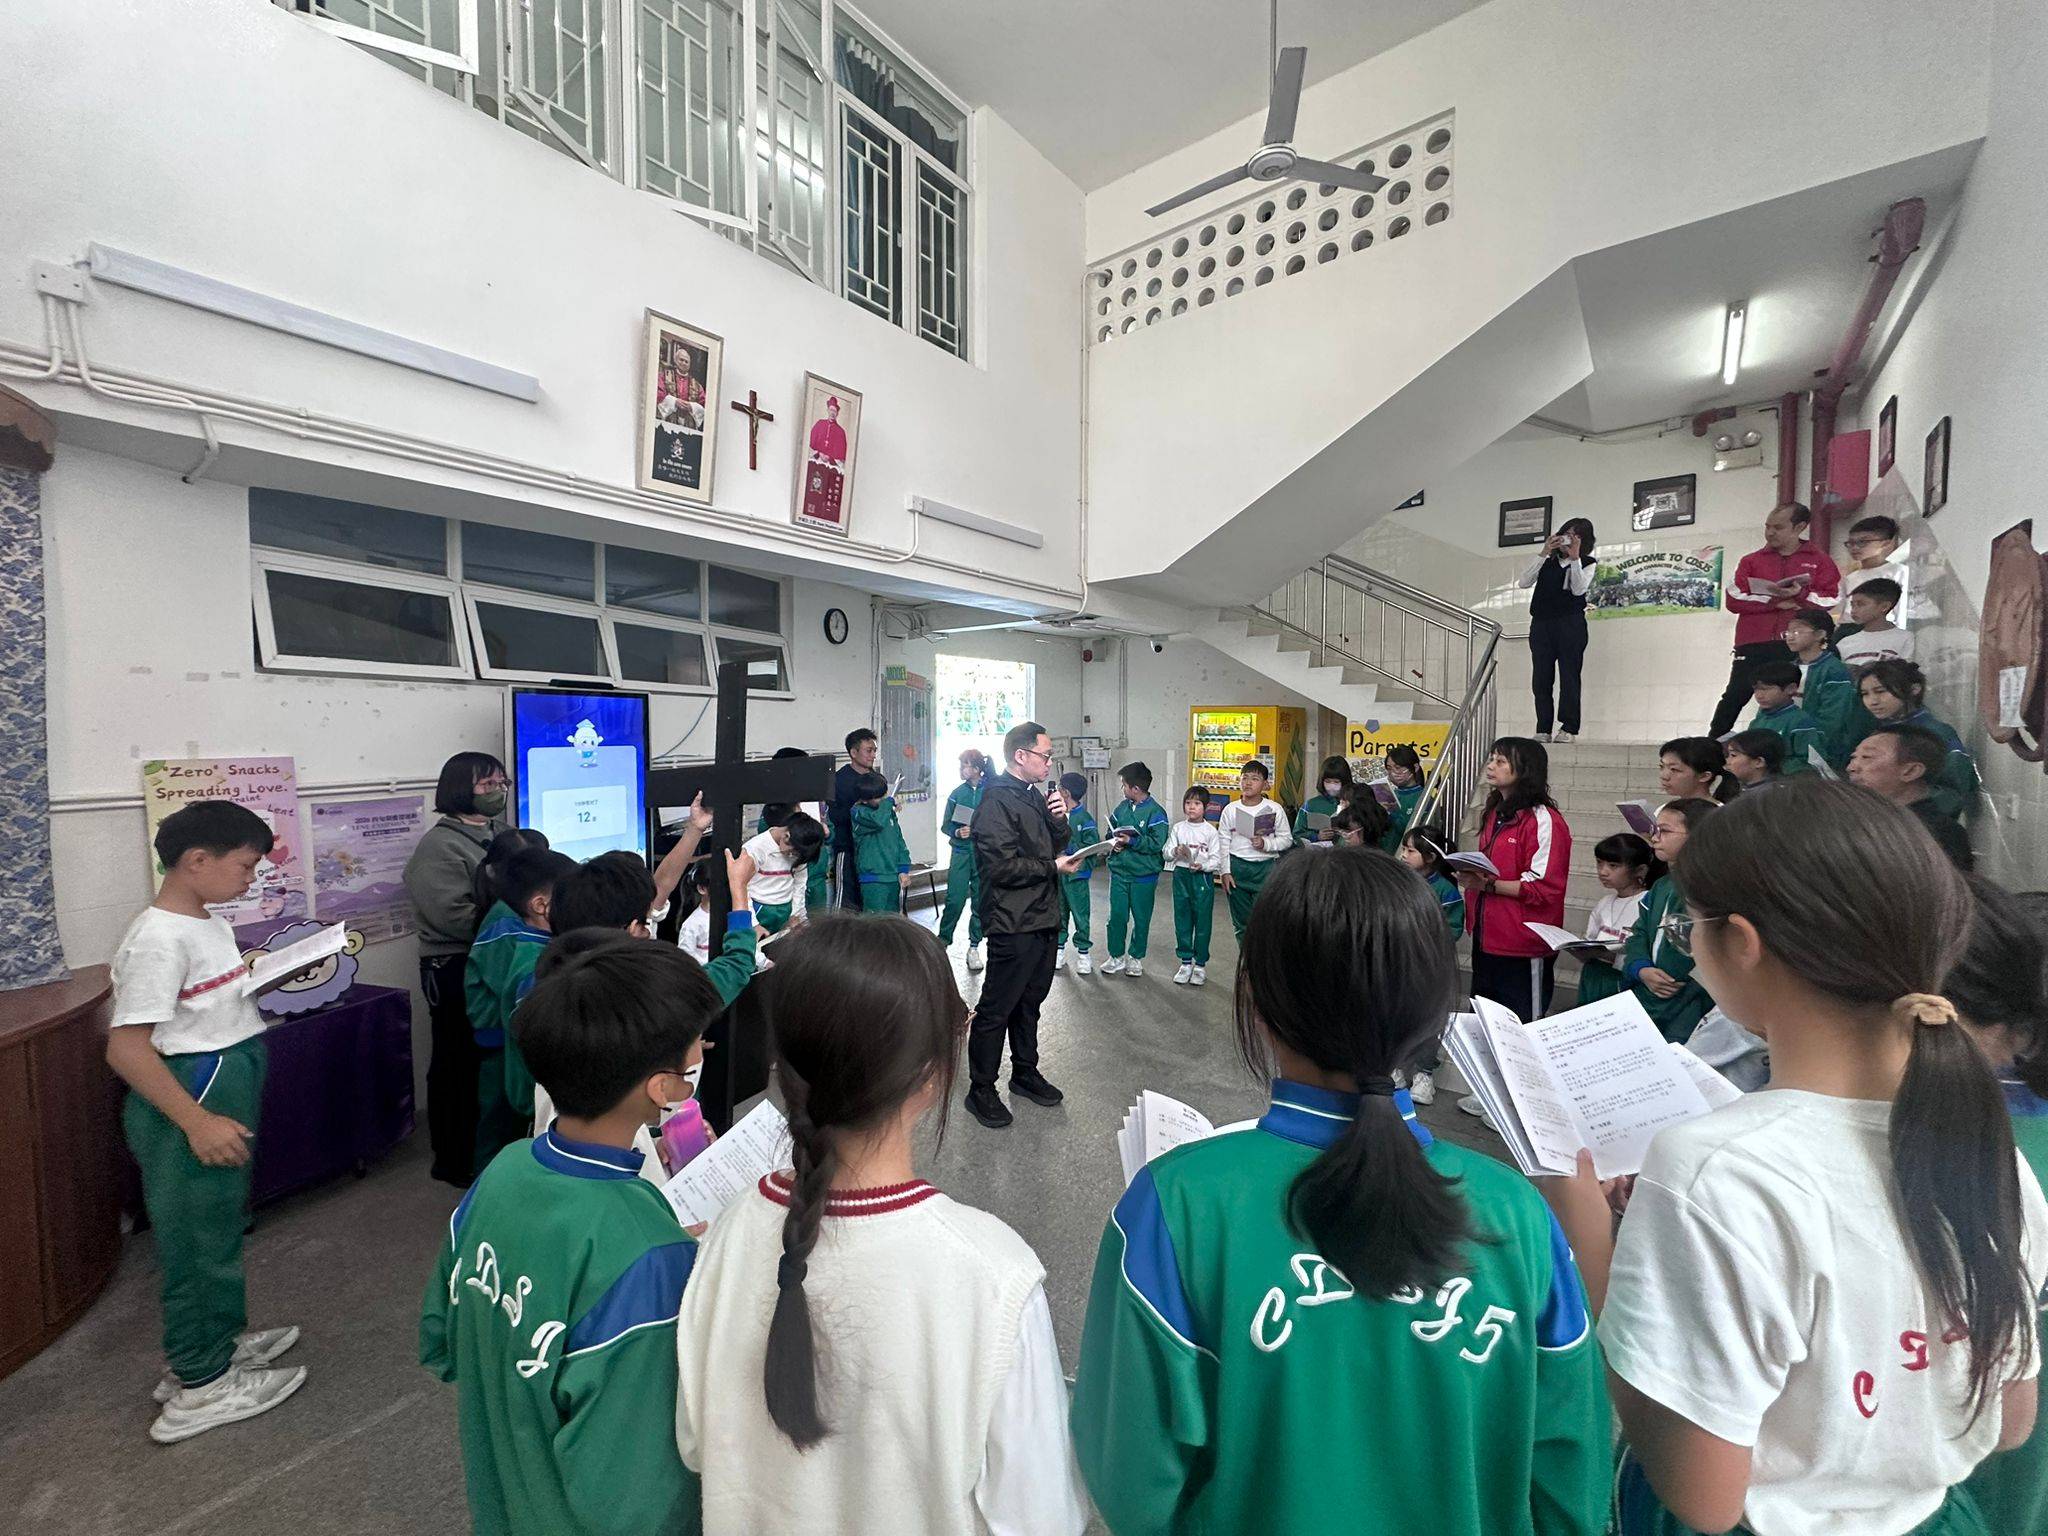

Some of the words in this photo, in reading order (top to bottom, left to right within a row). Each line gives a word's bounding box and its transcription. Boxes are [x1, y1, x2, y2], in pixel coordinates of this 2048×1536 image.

[1616, 553, 1666, 571] WELCOME
[1669, 553, 1683, 562] TO
[1350, 730, 1439, 758] Parets'
[228, 764, 280, 776] Snacks
[156, 784, 241, 801] Spreading
[248, 783, 288, 795] Love.
[267, 803, 295, 817] Lent
[577, 811, 591, 823] 12
